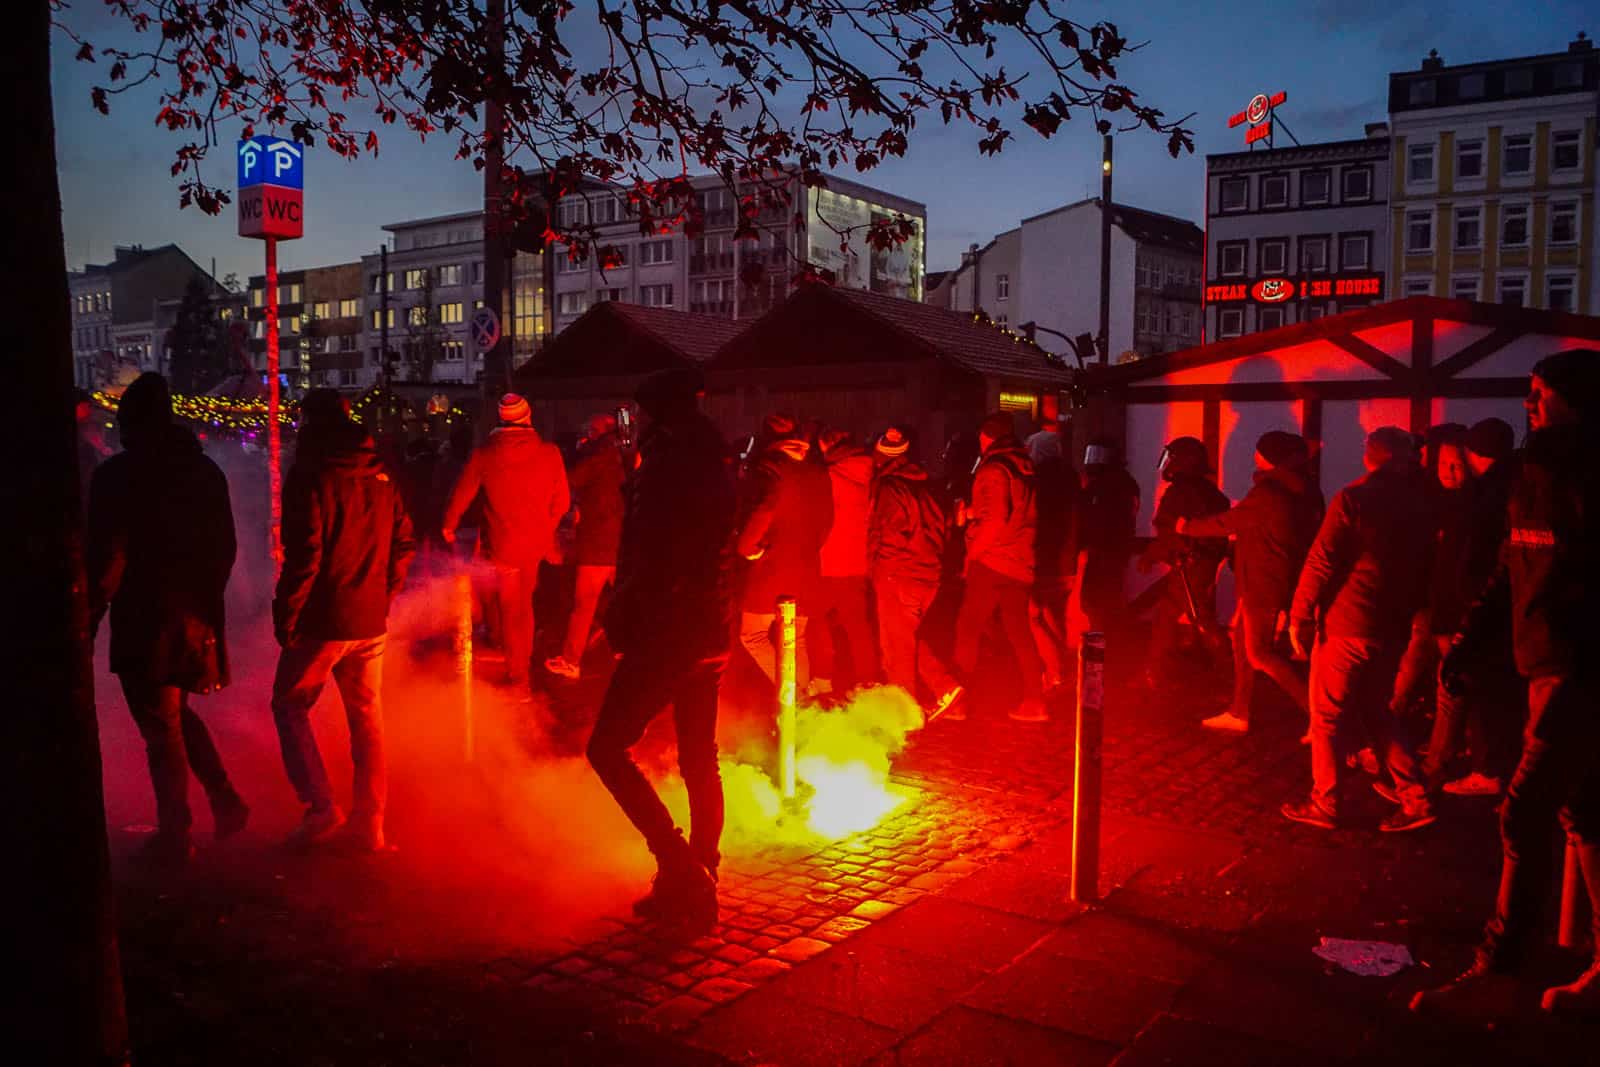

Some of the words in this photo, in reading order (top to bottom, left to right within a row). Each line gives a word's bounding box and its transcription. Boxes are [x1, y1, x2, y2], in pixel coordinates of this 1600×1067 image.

[244, 151, 257, 178] P
[275, 151, 293, 178] P
[240, 199, 262, 220] WC
[267, 197, 300, 222] WC
[1206, 284, 1247, 300] STEAK
[1300, 280, 1331, 297] FSH
[1335, 278, 1380, 295] HOUSE
